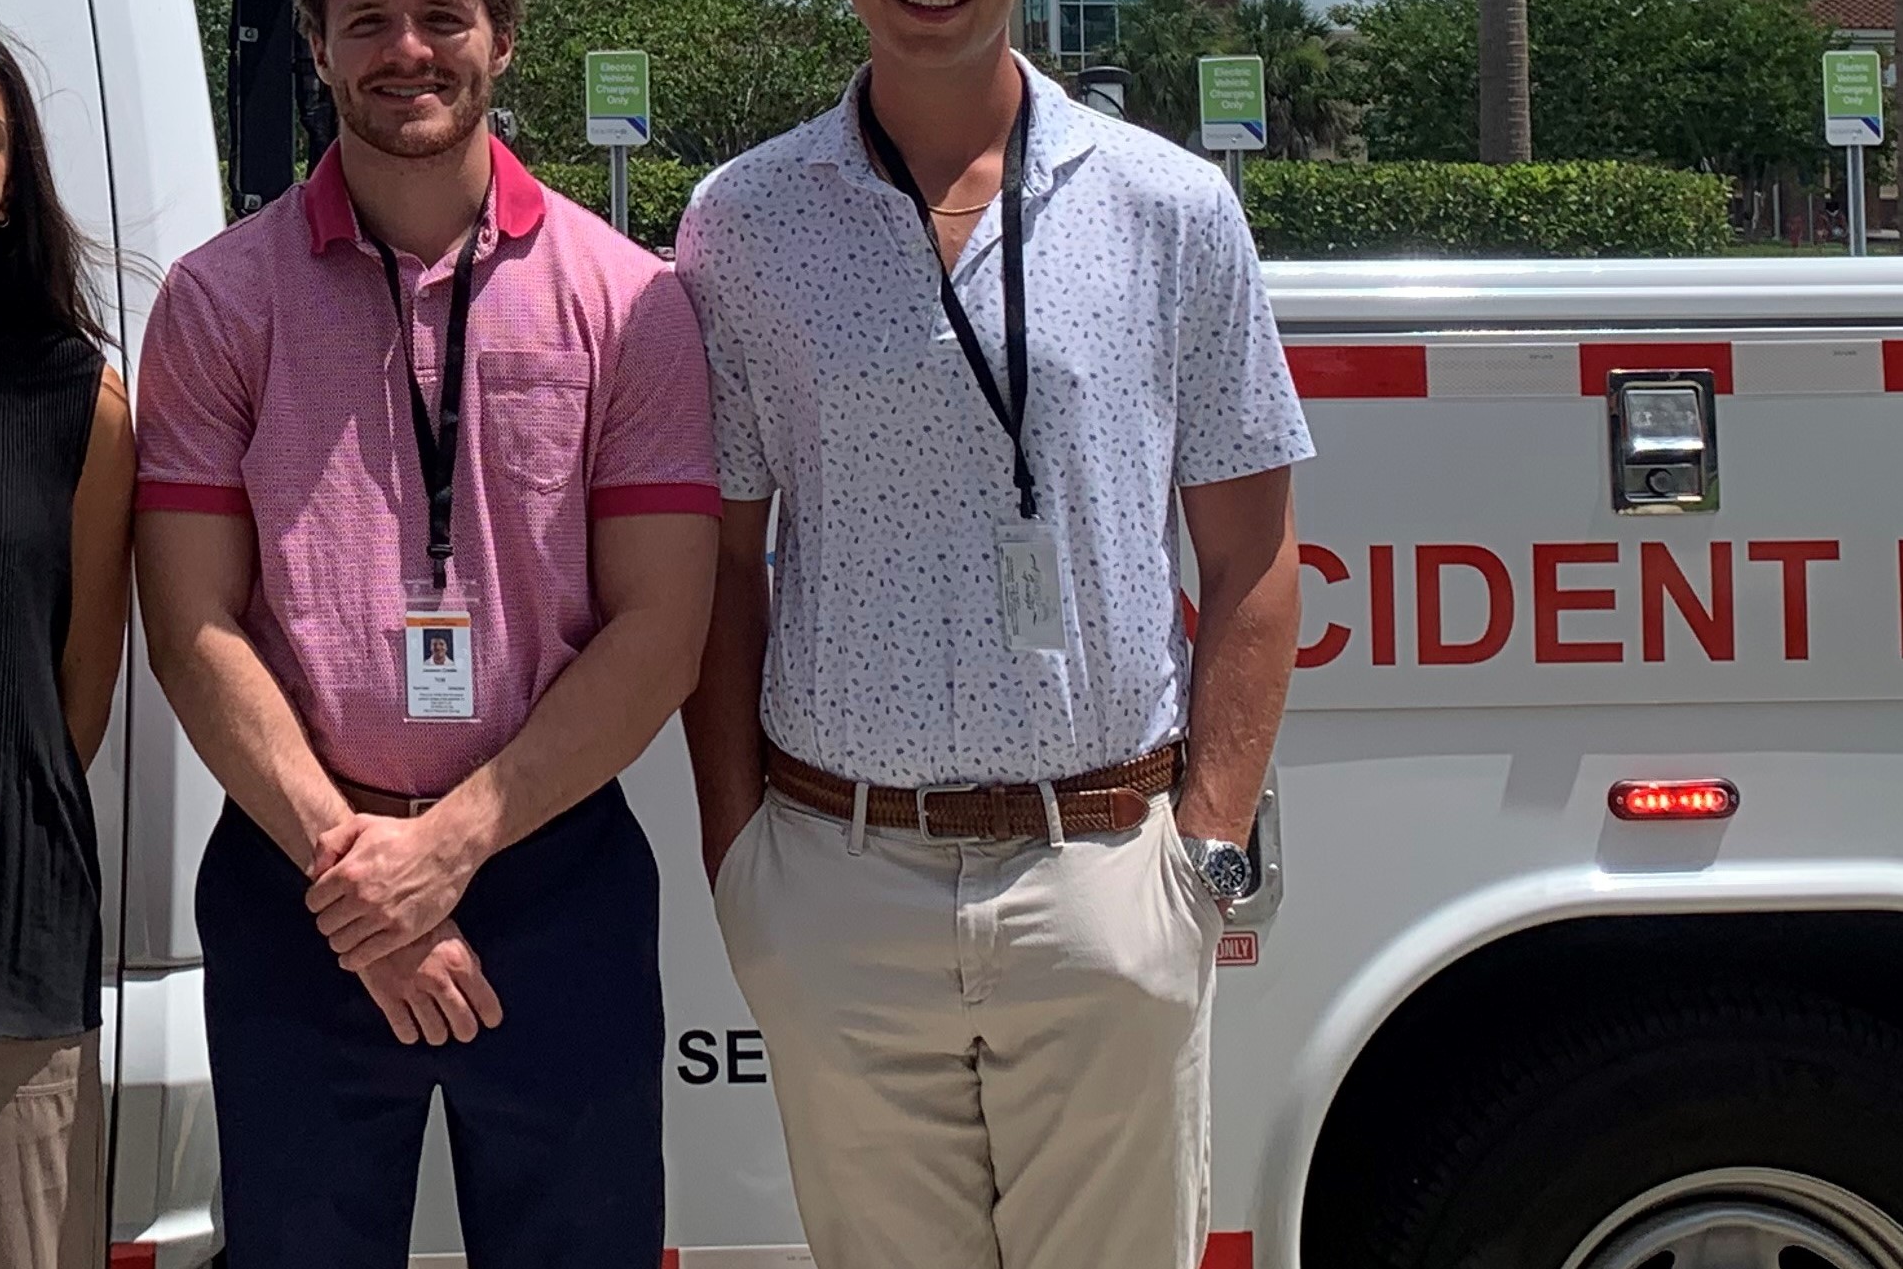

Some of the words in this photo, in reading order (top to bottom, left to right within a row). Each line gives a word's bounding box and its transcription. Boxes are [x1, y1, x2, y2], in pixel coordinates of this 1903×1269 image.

[600, 62, 637, 72] Electric
[599, 73, 635, 83] Vehicle
[595, 84, 640, 96] Charging
[607, 95, 629, 107] Only
[1181, 538, 1840, 668] CIDENT
